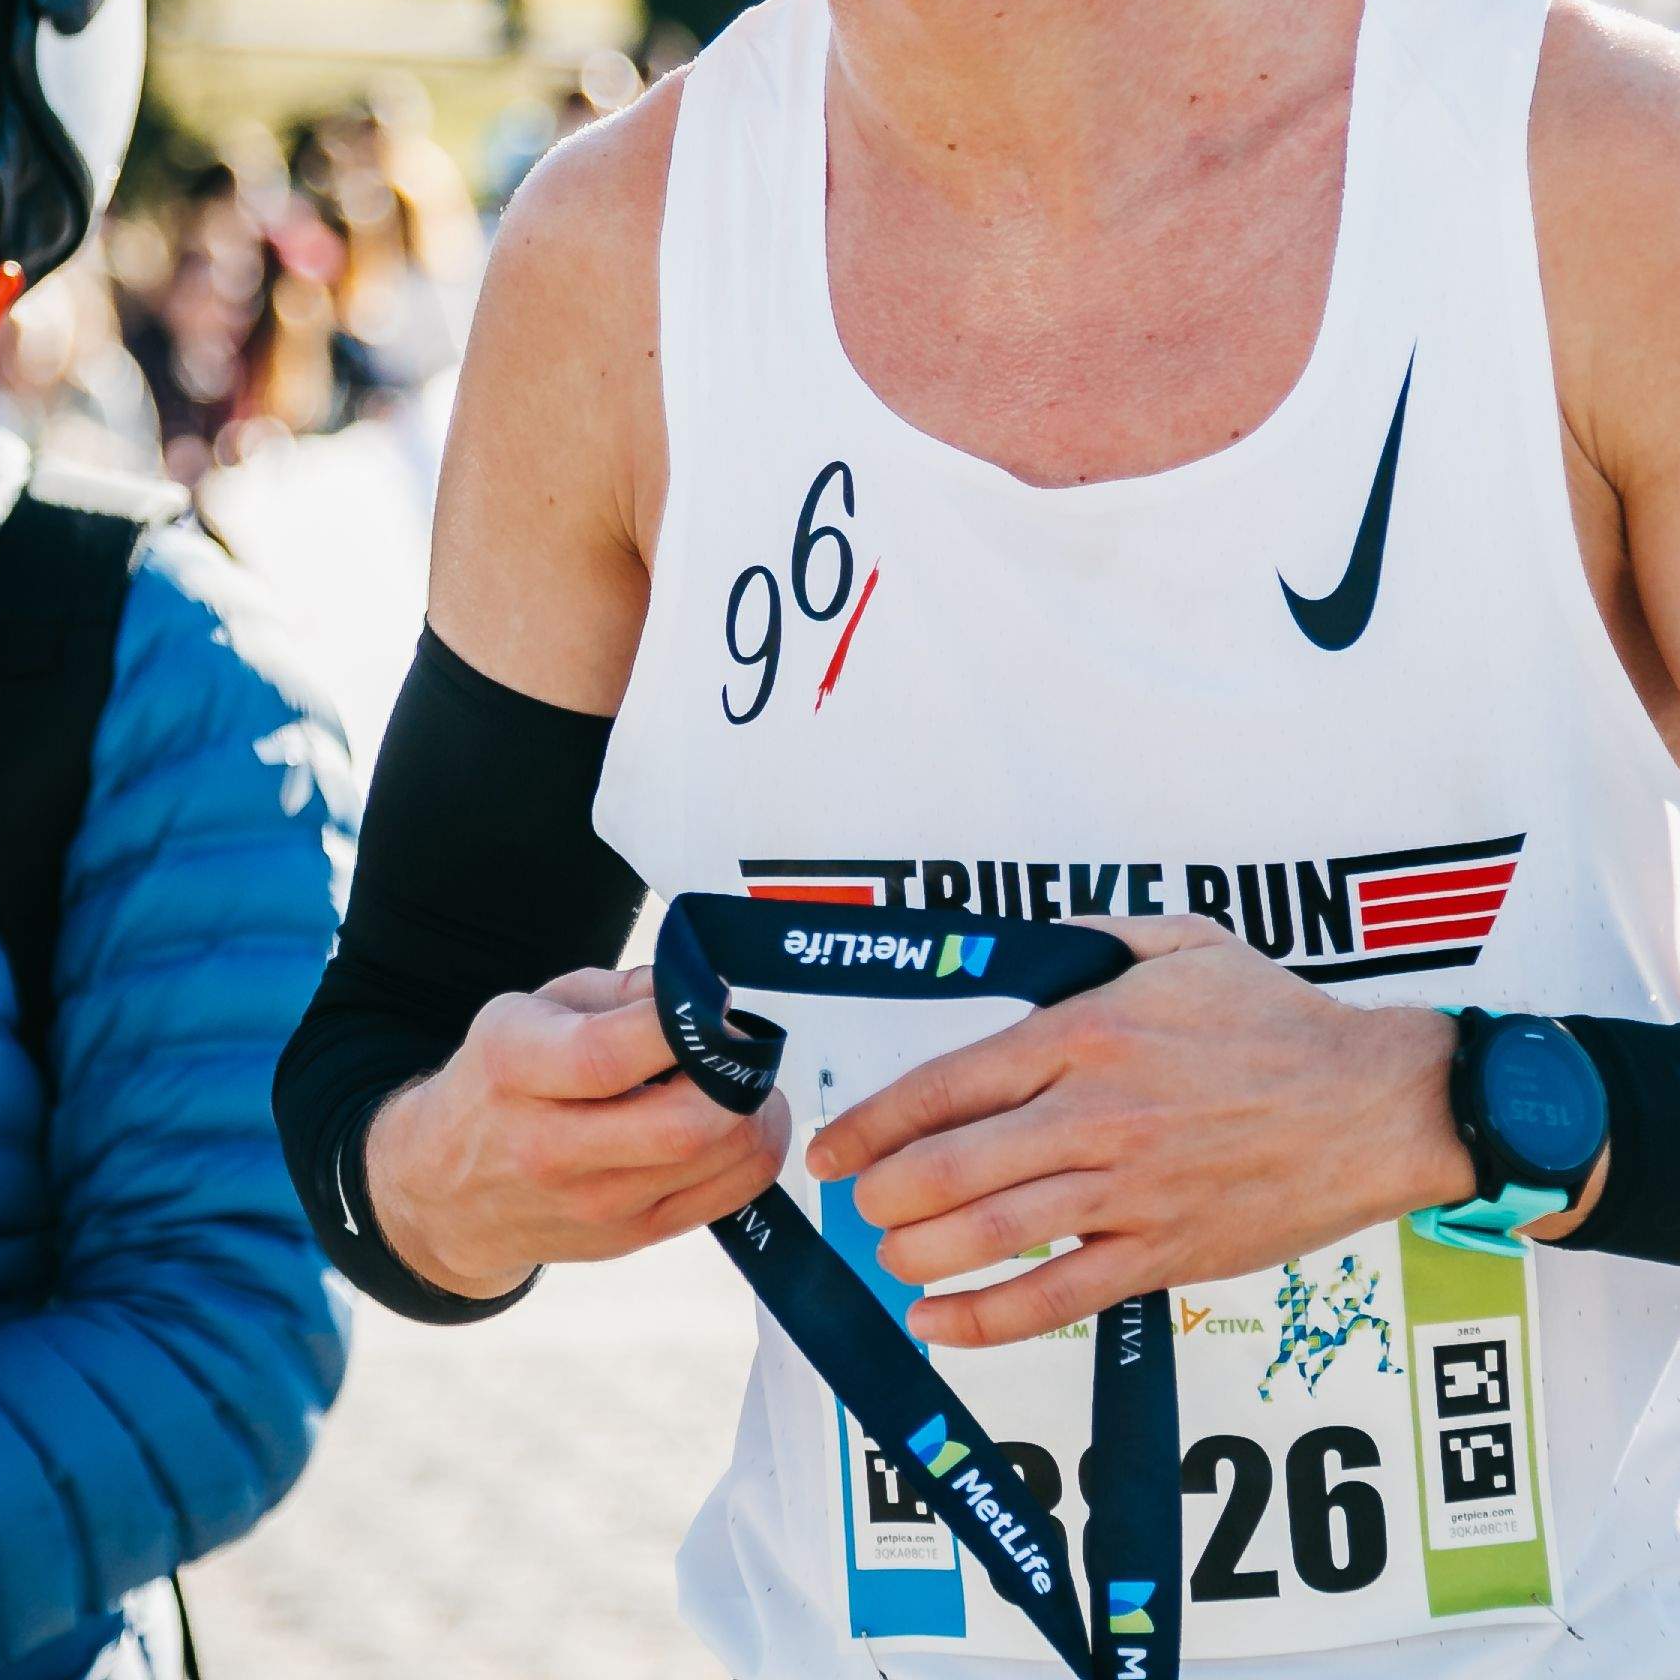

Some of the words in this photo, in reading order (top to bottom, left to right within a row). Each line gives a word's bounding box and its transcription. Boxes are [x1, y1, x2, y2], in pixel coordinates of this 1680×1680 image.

[1186, 860, 1354, 959] RUN
[783, 929, 932, 970] MetLife
[951, 1468, 1052, 1596] MetLife
[1450, 1506, 1515, 1524] getpica.com
[876, 1533, 935, 1546] getpica.com
